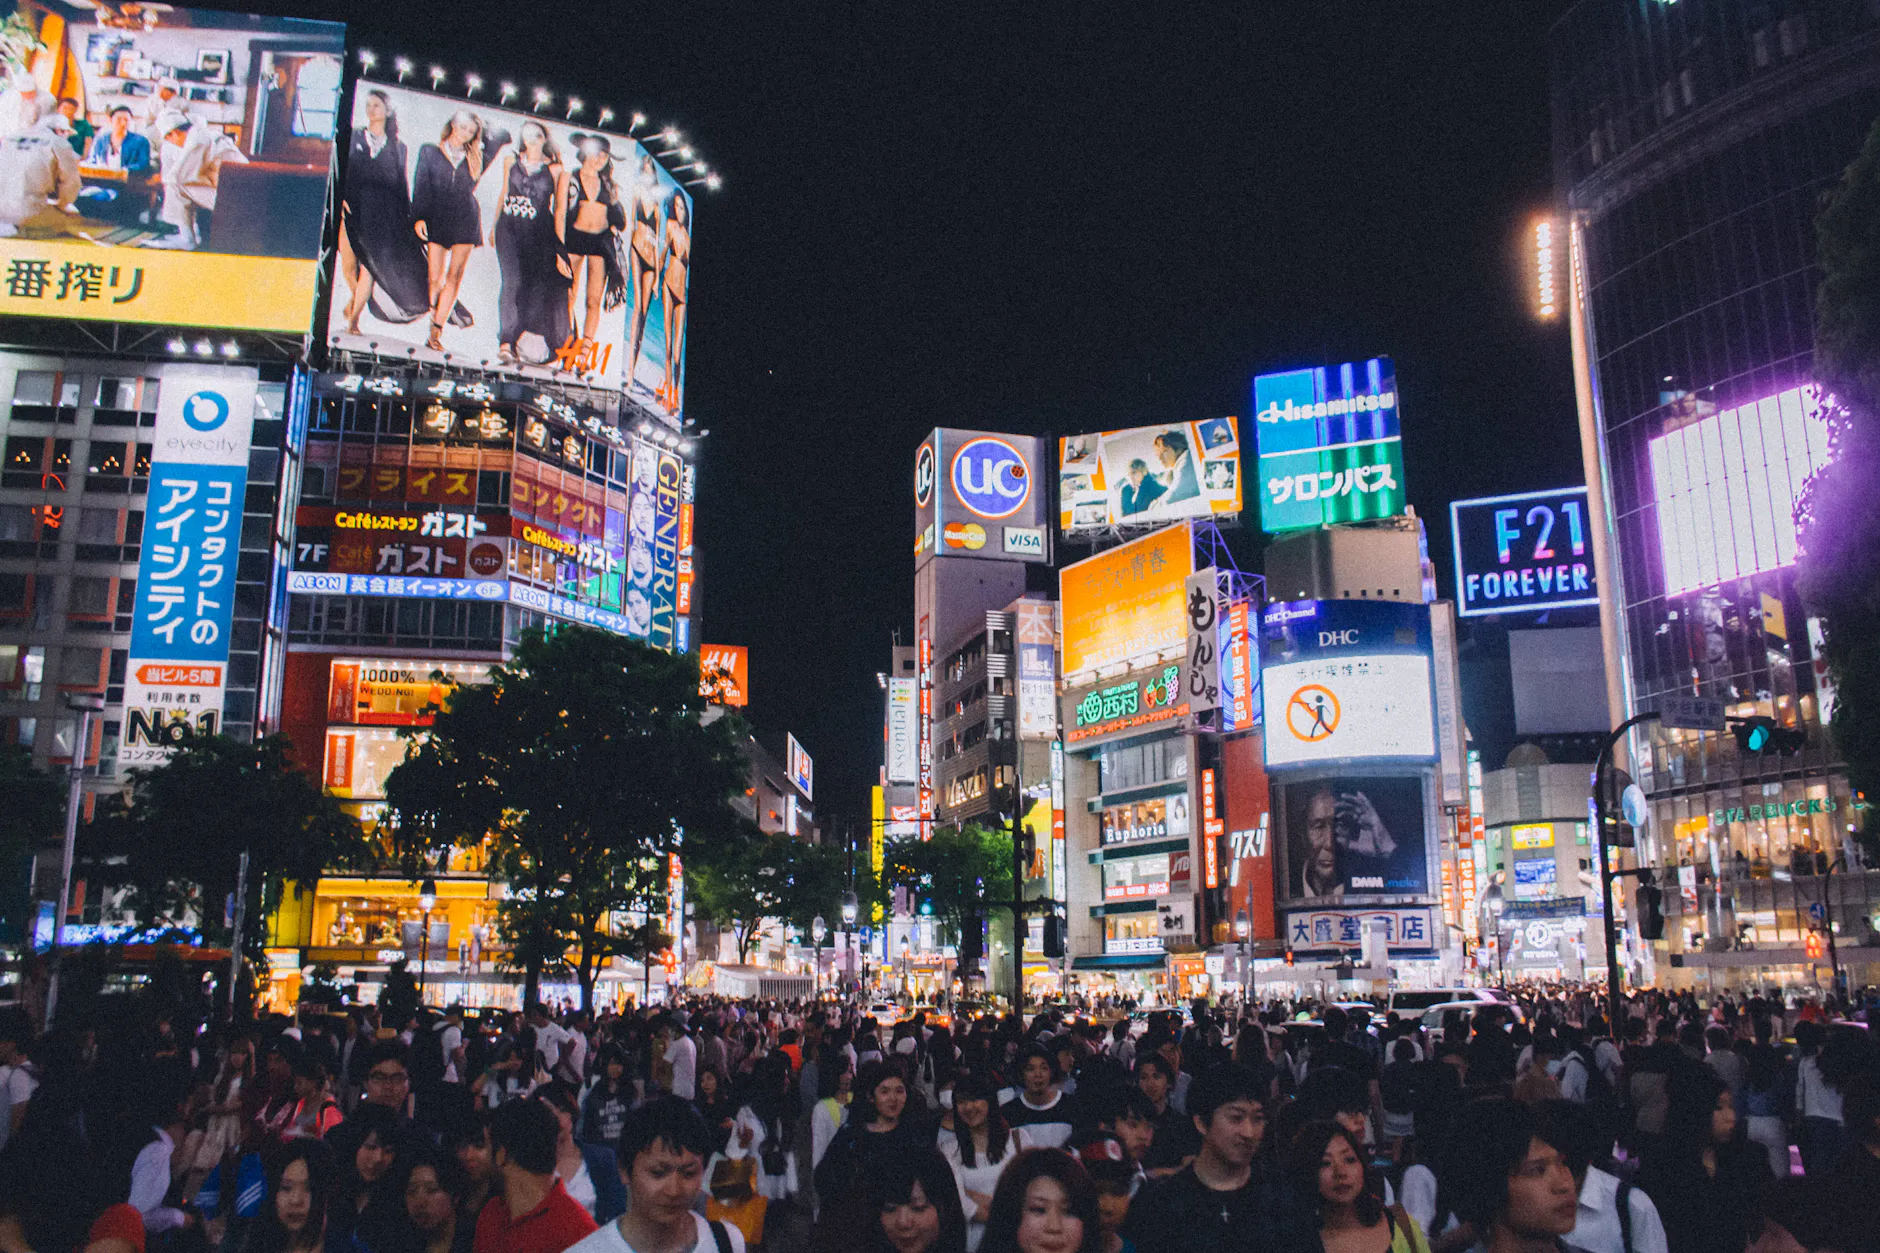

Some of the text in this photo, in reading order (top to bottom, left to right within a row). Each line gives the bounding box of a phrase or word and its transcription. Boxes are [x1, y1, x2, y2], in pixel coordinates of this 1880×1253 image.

[1257, 392, 1395, 423] Hisamitsu
[1268, 464, 1397, 504] サロンパス
[513, 479, 601, 528] コンタクト
[420, 511, 487, 539] ガスト
[1495, 501, 1585, 564] F21
[298, 543, 329, 562] 7F
[1010, 534, 1040, 548] VISA
[147, 478, 199, 645] アイシティ
[190, 480, 233, 645] コンタクトの
[376, 543, 457, 575] ガスト
[577, 543, 619, 572] ガスト
[293, 575, 341, 590] AEON
[350, 576, 471, 596] 英会話イーオン
[1466, 563, 1589, 601] FOREVER
[514, 586, 546, 608] AEON
[1318, 629, 1360, 648] DHC
[146, 668, 215, 684] 当ビル5階
[361, 669, 416, 684] 1000%
[147, 692, 201, 703] 利用者数
[1714, 796, 1837, 825] STARBUCKS
[1106, 822, 1165, 843] Euphoria
